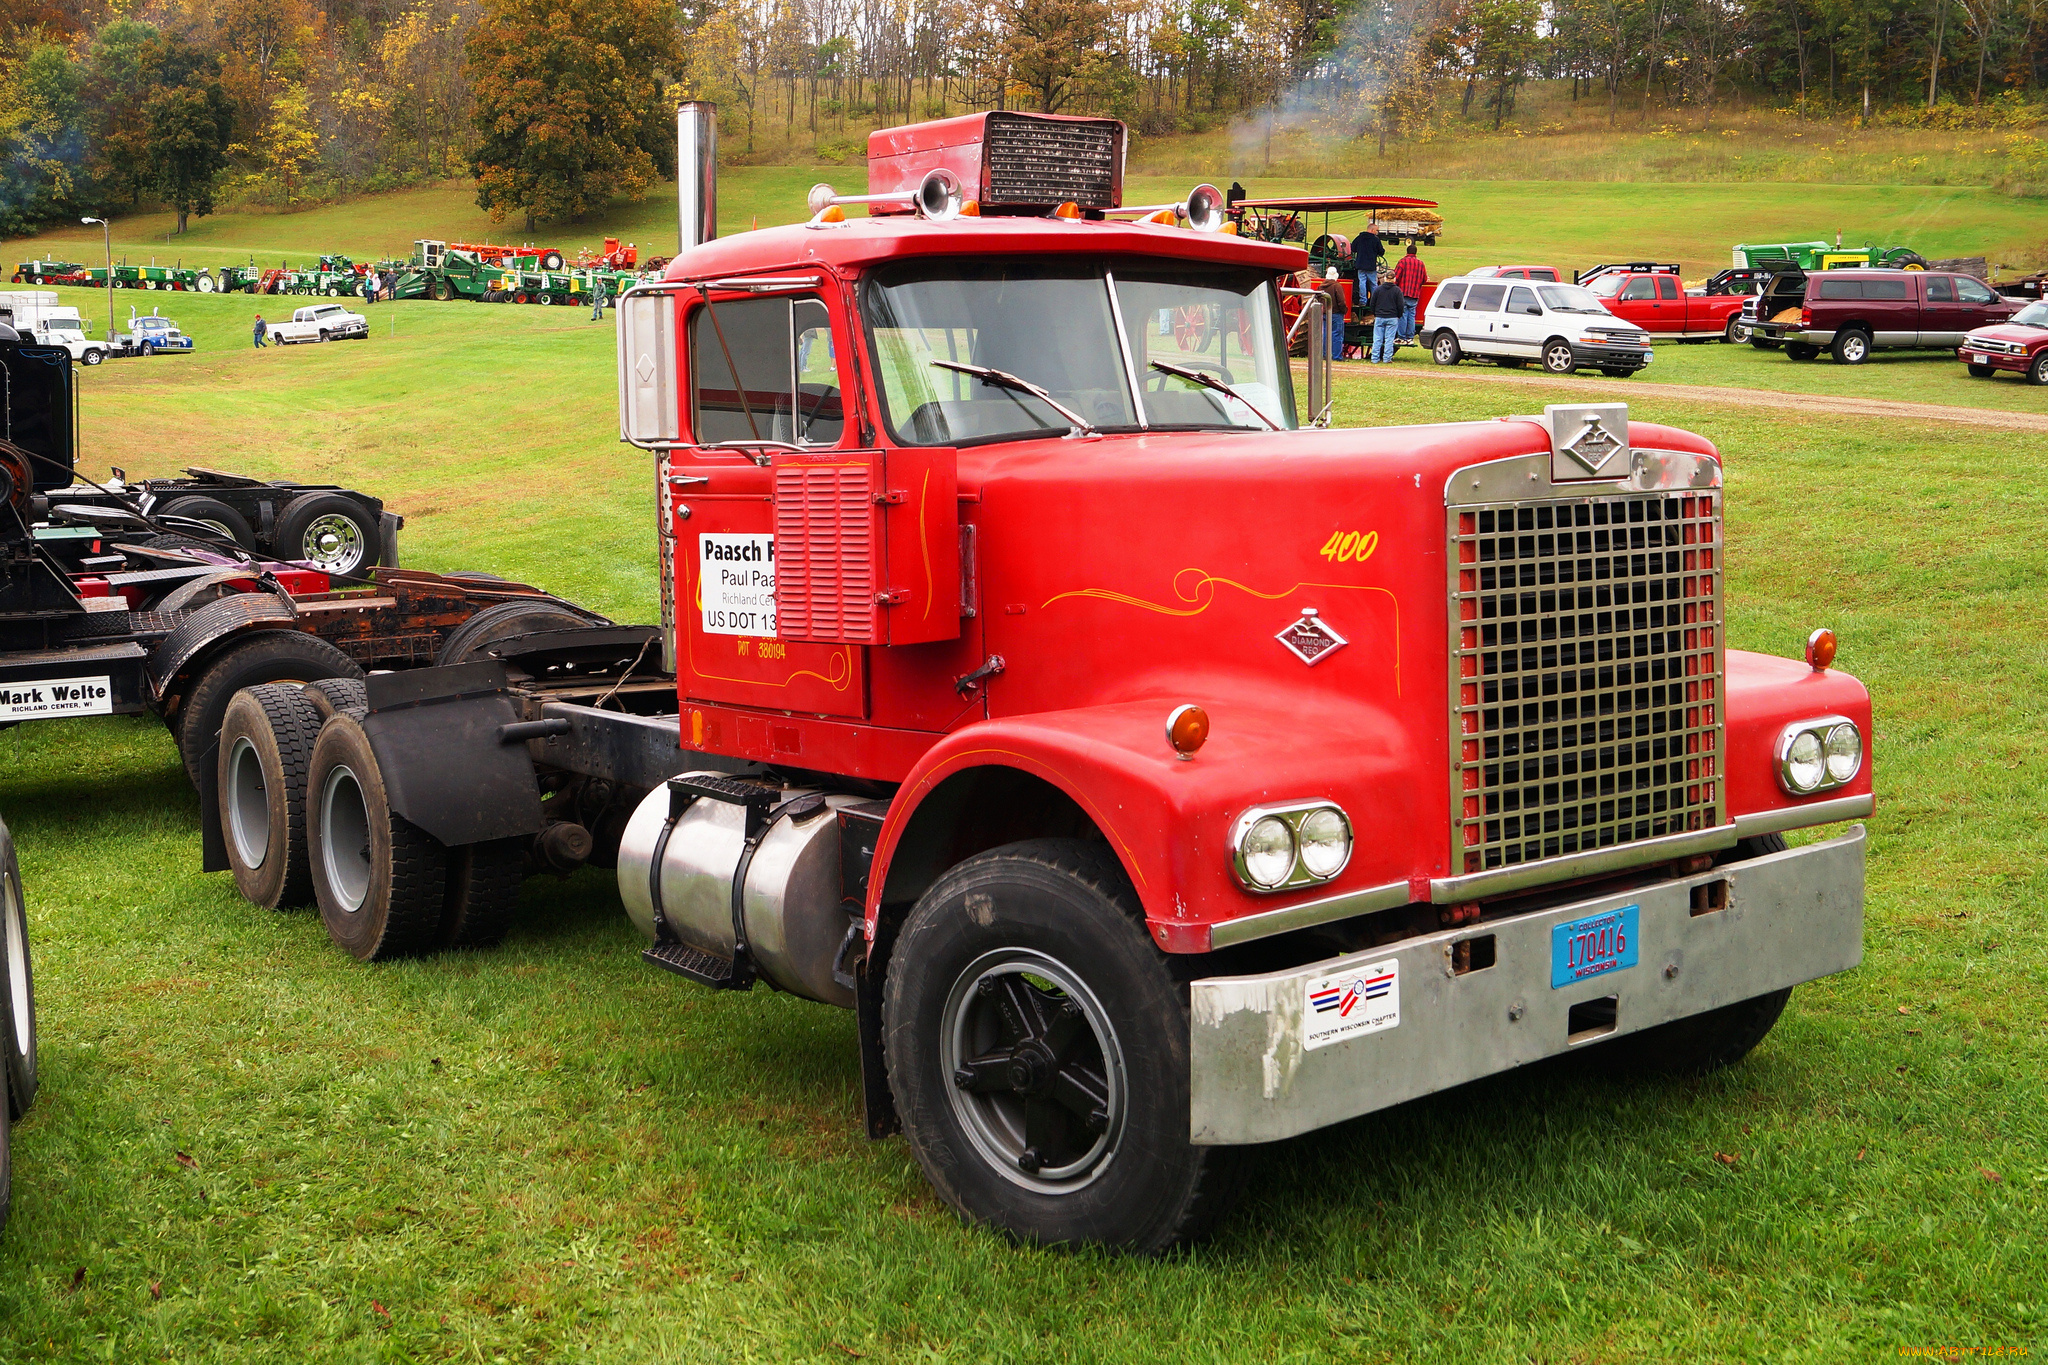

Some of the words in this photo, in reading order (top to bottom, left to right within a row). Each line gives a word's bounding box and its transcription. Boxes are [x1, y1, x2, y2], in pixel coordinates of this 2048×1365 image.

[705, 539, 761, 562] Paasch
[1320, 530, 1378, 562] 400
[722, 569, 748, 586] Paul
[722, 592, 757, 606] Richland
[708, 610, 725, 627] US
[729, 611, 756, 629] DOT
[737, 640, 750, 656] DOT
[758, 642, 786, 660] 380194
[1291, 636, 1330, 647] DIAMOND
[1302, 645, 1319, 655] REO
[0, 688, 43, 705] Mark
[52, 685, 106, 701] Welte
[51, 702, 81, 710] CENTER,
[1578, 914, 1615, 931] COLLECTOR
[1567, 922, 1626, 968] 170416
[1575, 958, 1617, 978] WISCONSIN
[1309, 1028, 1338, 1041] SOUTHERN
[1340, 1019, 1370, 1033] WISCONSIN
[1371, 1012, 1396, 1024] CHAPTER
